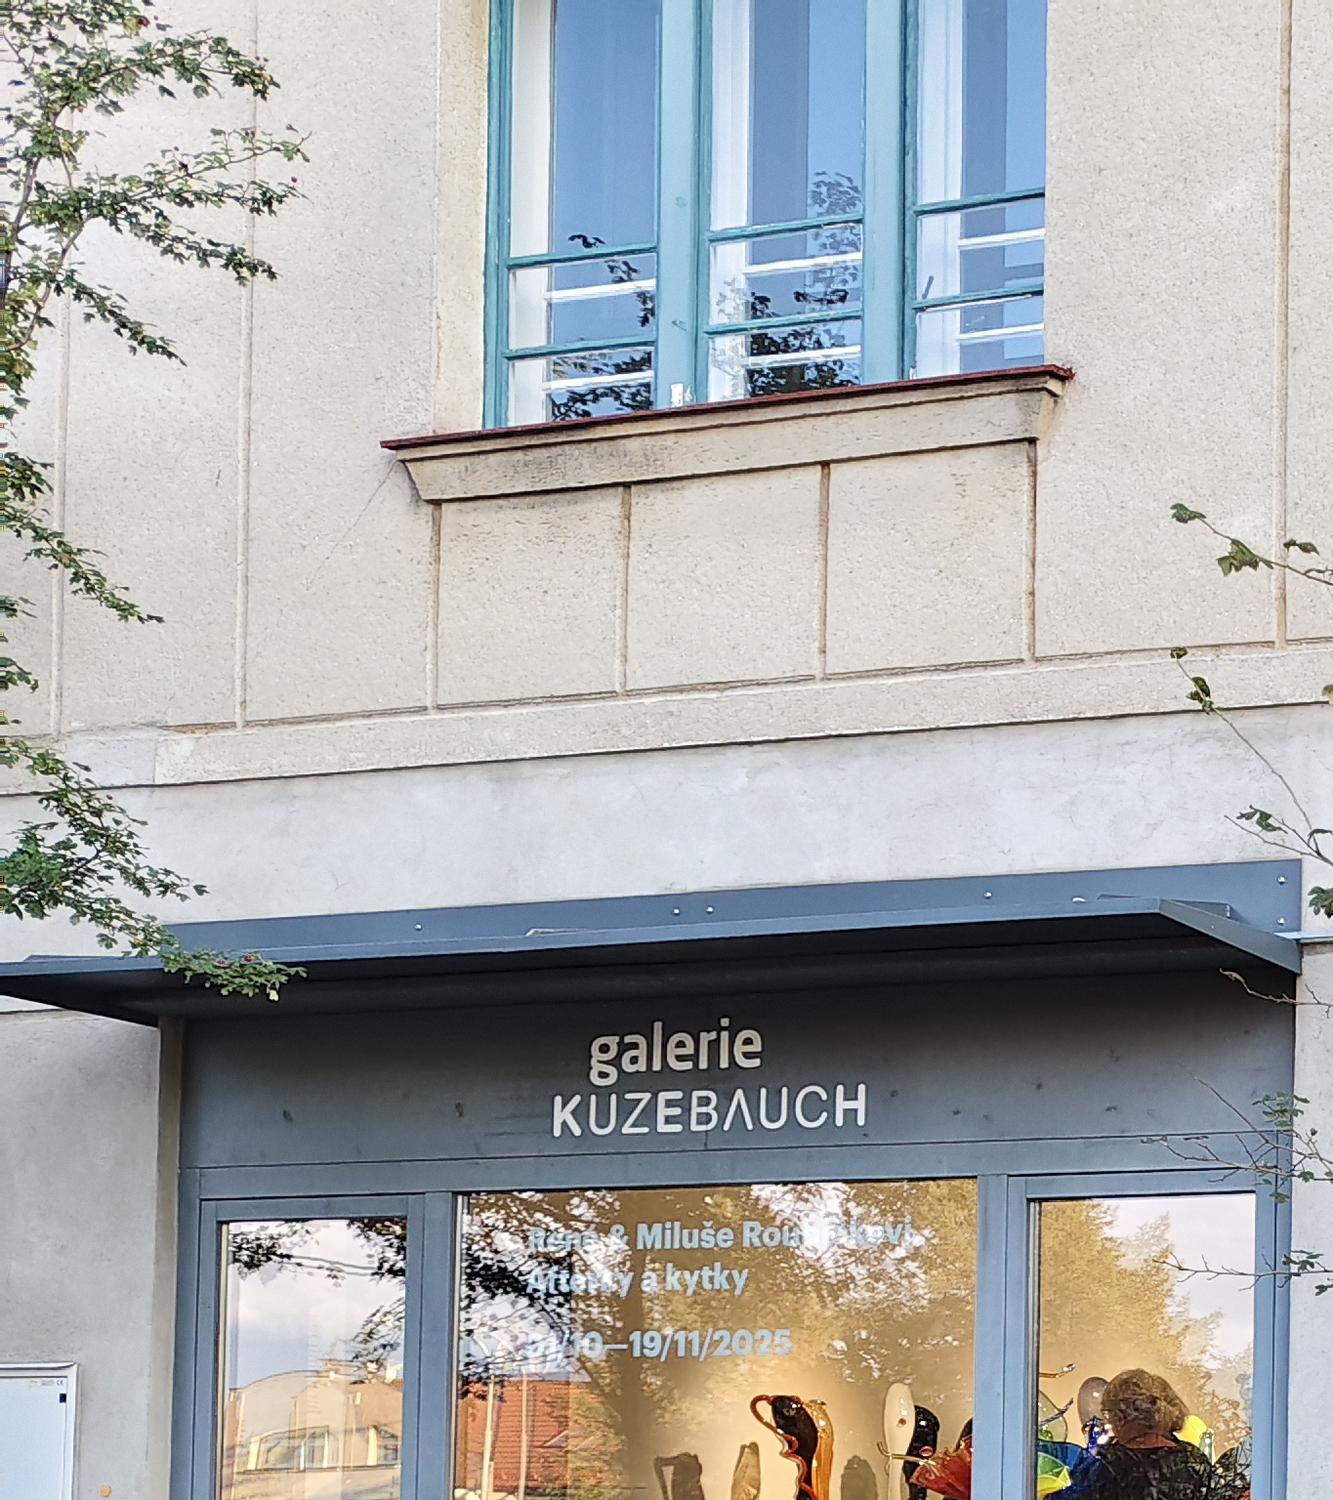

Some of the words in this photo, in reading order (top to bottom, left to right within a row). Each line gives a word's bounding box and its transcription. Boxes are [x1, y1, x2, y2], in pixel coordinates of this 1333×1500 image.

[589, 1018, 764, 1087] galerie
[553, 1082, 867, 1139] KUZEBAUCH
[636, 1220, 735, 1250] Miluše
[640, 1271, 658, 1292] a
[665, 1262, 749, 1297] kytky
